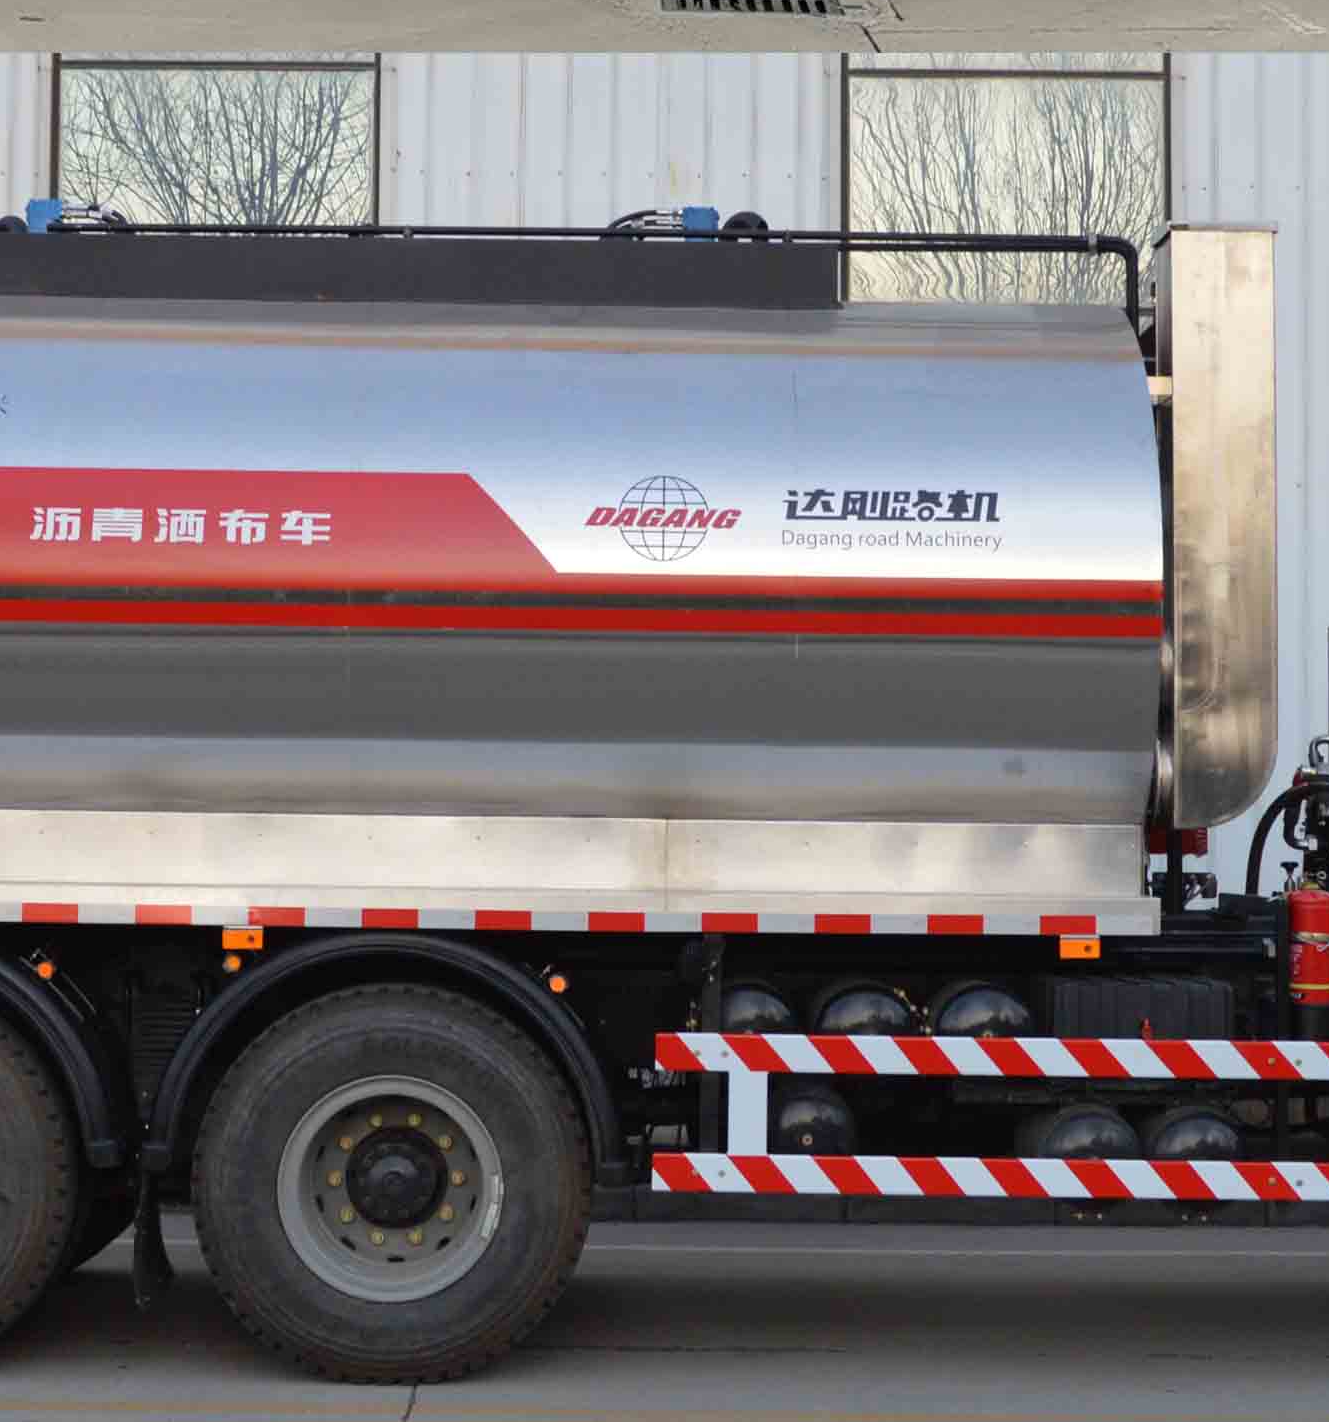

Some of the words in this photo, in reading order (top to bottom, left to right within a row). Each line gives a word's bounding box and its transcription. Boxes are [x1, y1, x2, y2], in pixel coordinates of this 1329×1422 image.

[584, 506, 743, 529] DAGANG
[782, 489, 1000, 522] 达刚路机
[30, 507, 331, 545] 沥青洒布车
[781, 530, 854, 550] Dagang
[858, 531, 901, 547] road
[905, 532, 1003, 552] Machinery
